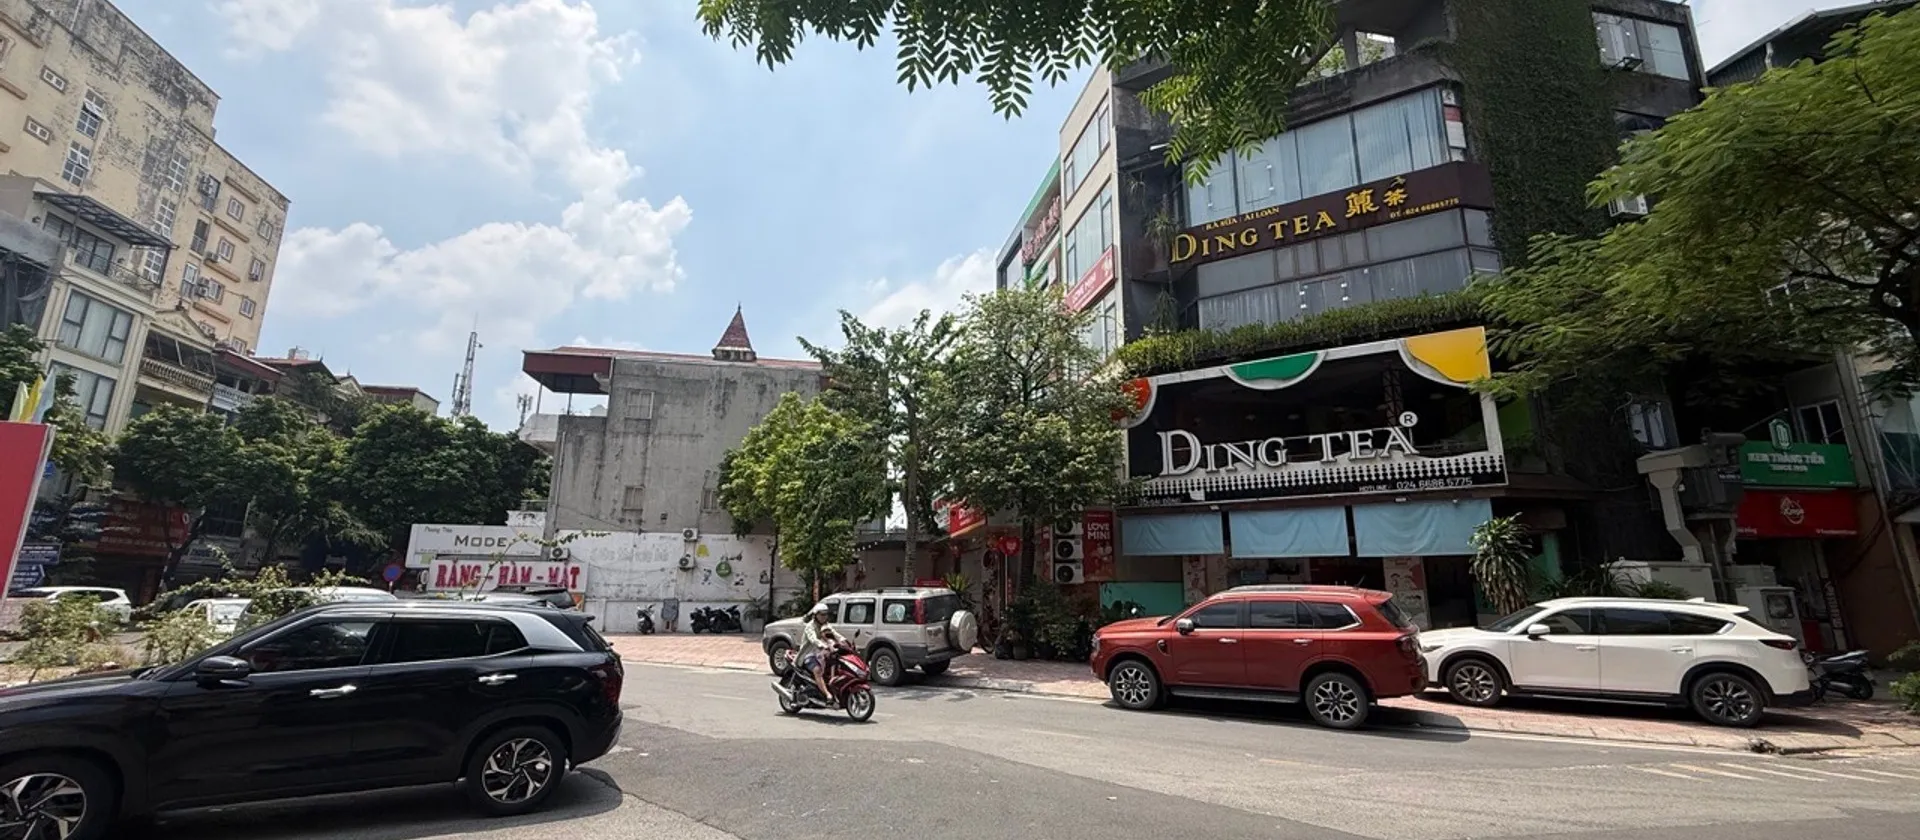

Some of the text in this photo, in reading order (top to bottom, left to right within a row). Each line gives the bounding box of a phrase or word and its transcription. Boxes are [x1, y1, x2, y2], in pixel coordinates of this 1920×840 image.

[1267, 211, 1336, 240] TEA
[1308, 426, 1420, 462] TEA
[1087, 522, 1110, 532] LOVE
[454, 534, 507, 548] MODE
[1087, 531, 1110, 541] MINI
